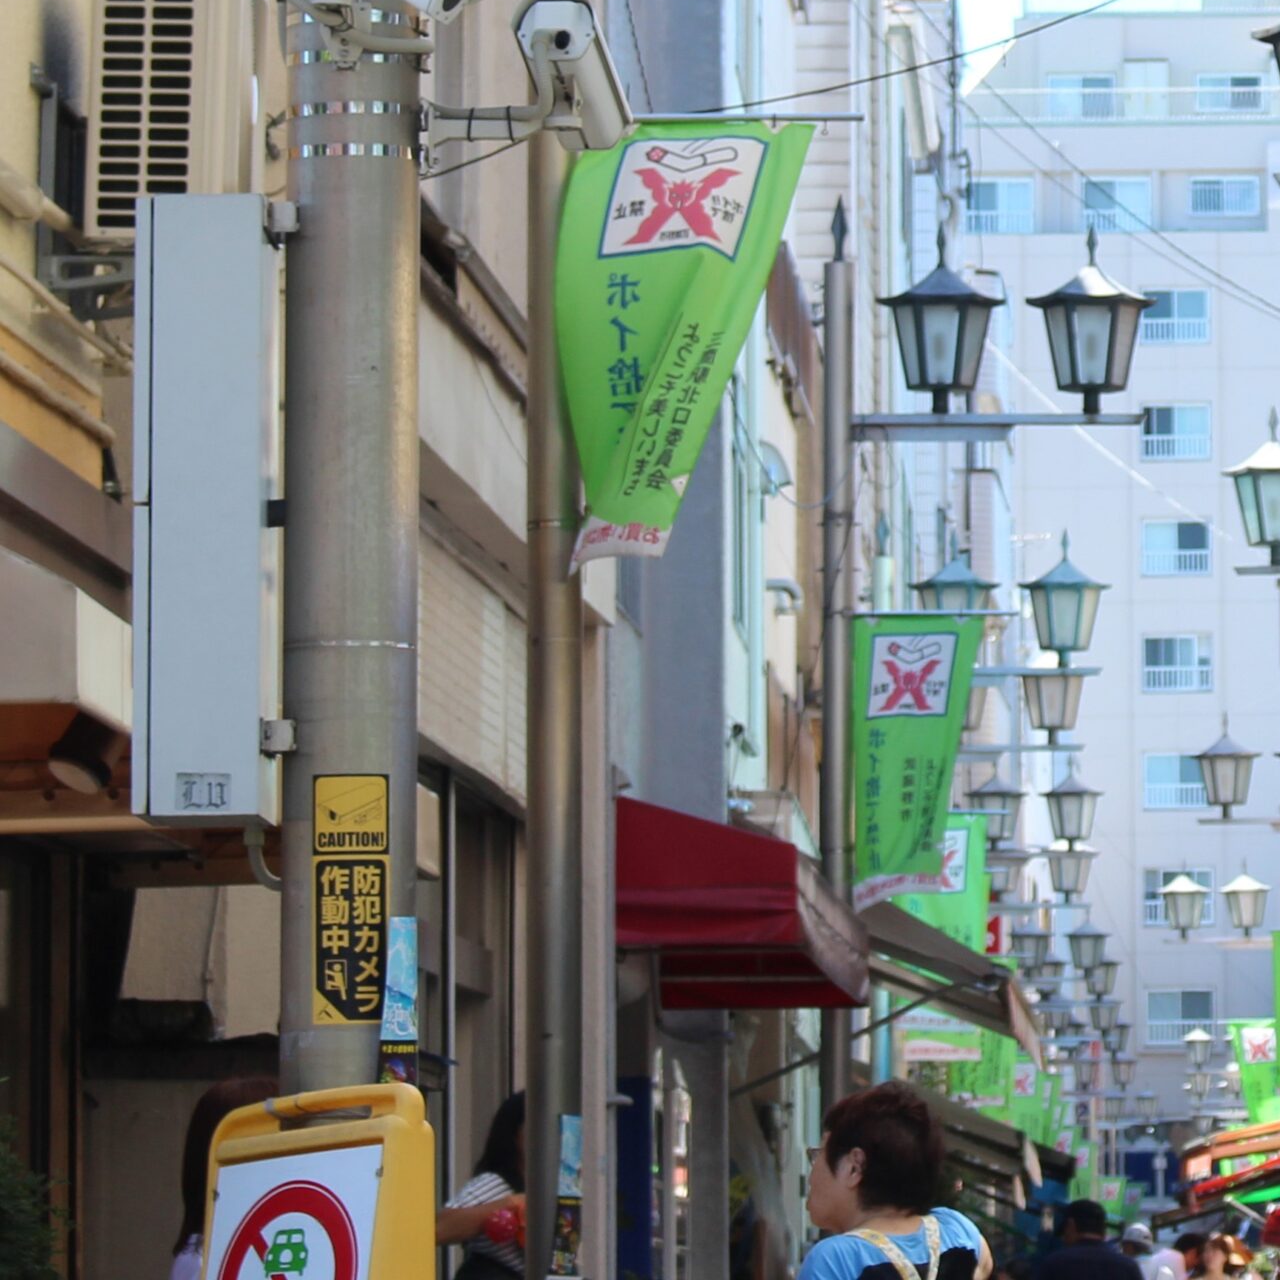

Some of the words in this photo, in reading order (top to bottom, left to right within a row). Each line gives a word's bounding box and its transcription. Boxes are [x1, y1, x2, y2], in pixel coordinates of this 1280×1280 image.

[317, 831, 385, 848] CAUTION!
[320, 865, 350, 955] 作動中
[352, 865, 382, 1013] 防犯カメラ
